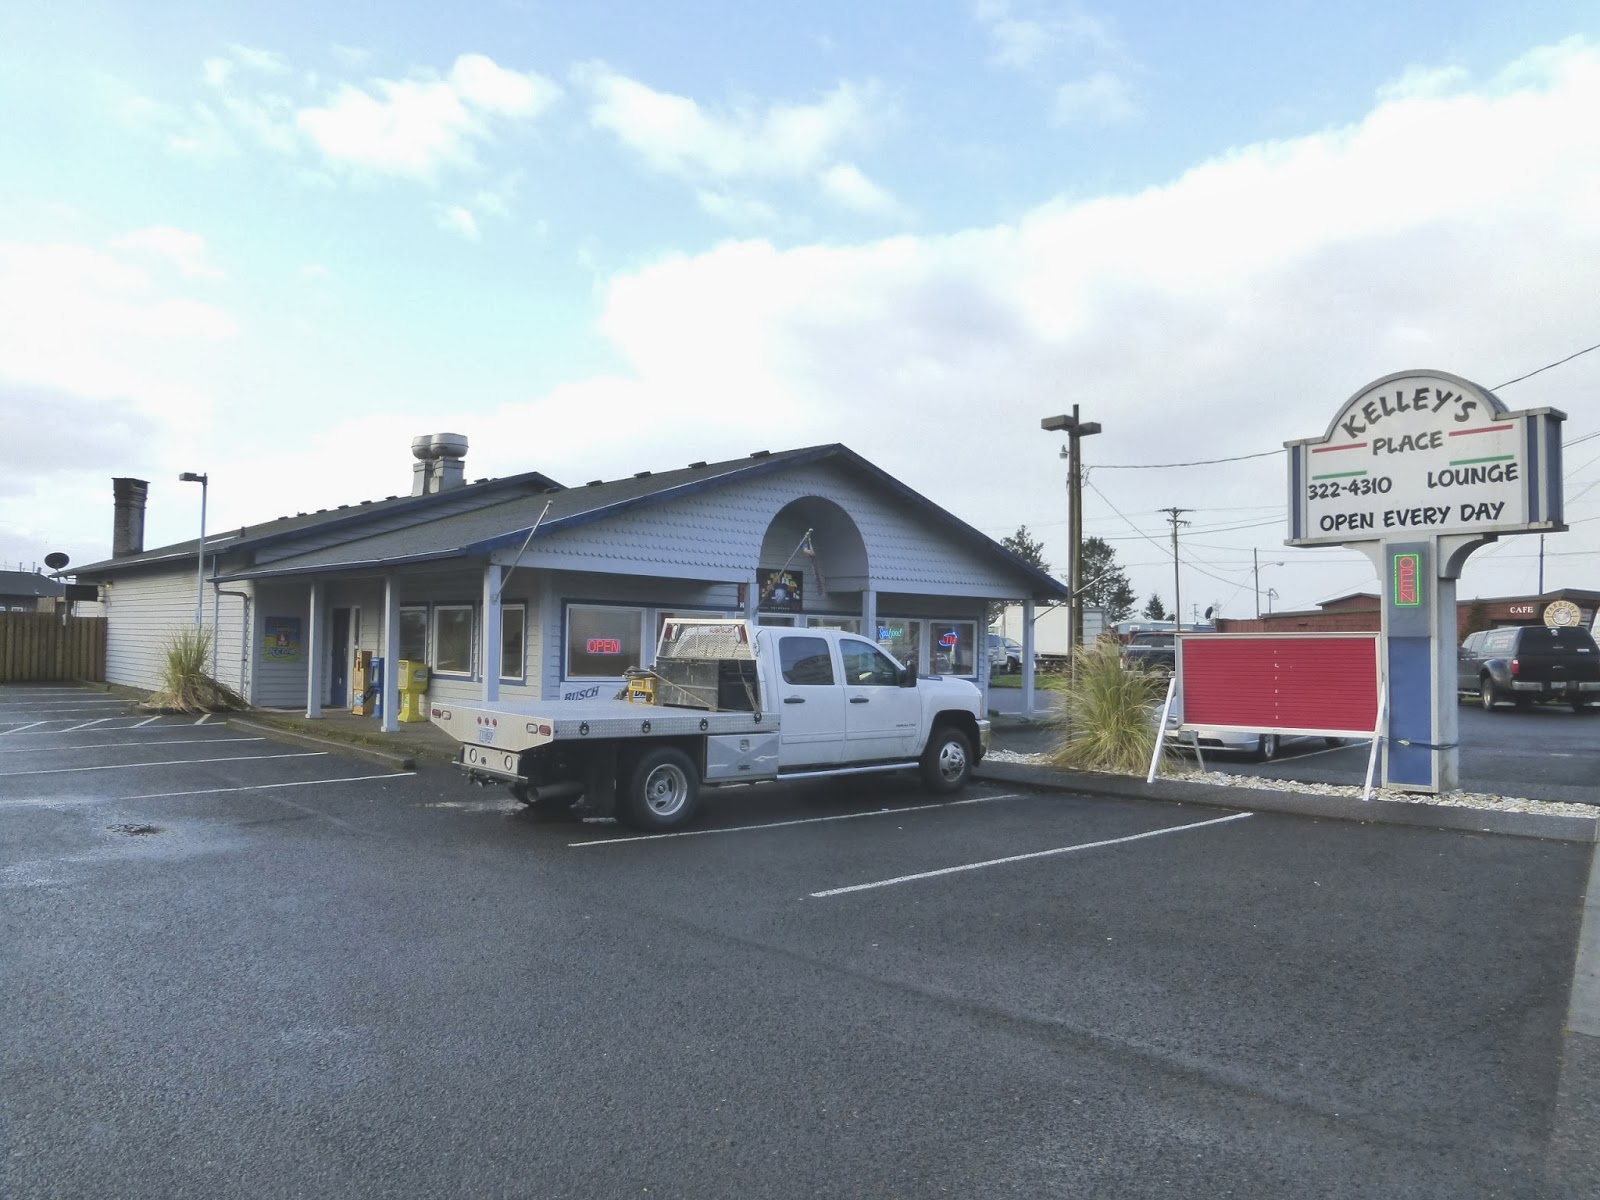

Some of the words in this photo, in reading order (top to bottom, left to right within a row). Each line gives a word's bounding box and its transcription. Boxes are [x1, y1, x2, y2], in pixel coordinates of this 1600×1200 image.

[1341, 387, 1477, 439] KELLEY'S
[1372, 430, 1444, 456] PLACE
[1308, 477, 1392, 500] 322-4310
[1427, 463, 1519, 489] LOUNGE
[1320, 512, 1374, 531] OPEN
[1383, 506, 1451, 528] EVERY
[1460, 501, 1505, 522] DAY
[1400, 557, 1414, 602] OPEN
[588, 640, 620, 652] OPEN
[564, 686, 600, 700] BUSCH
